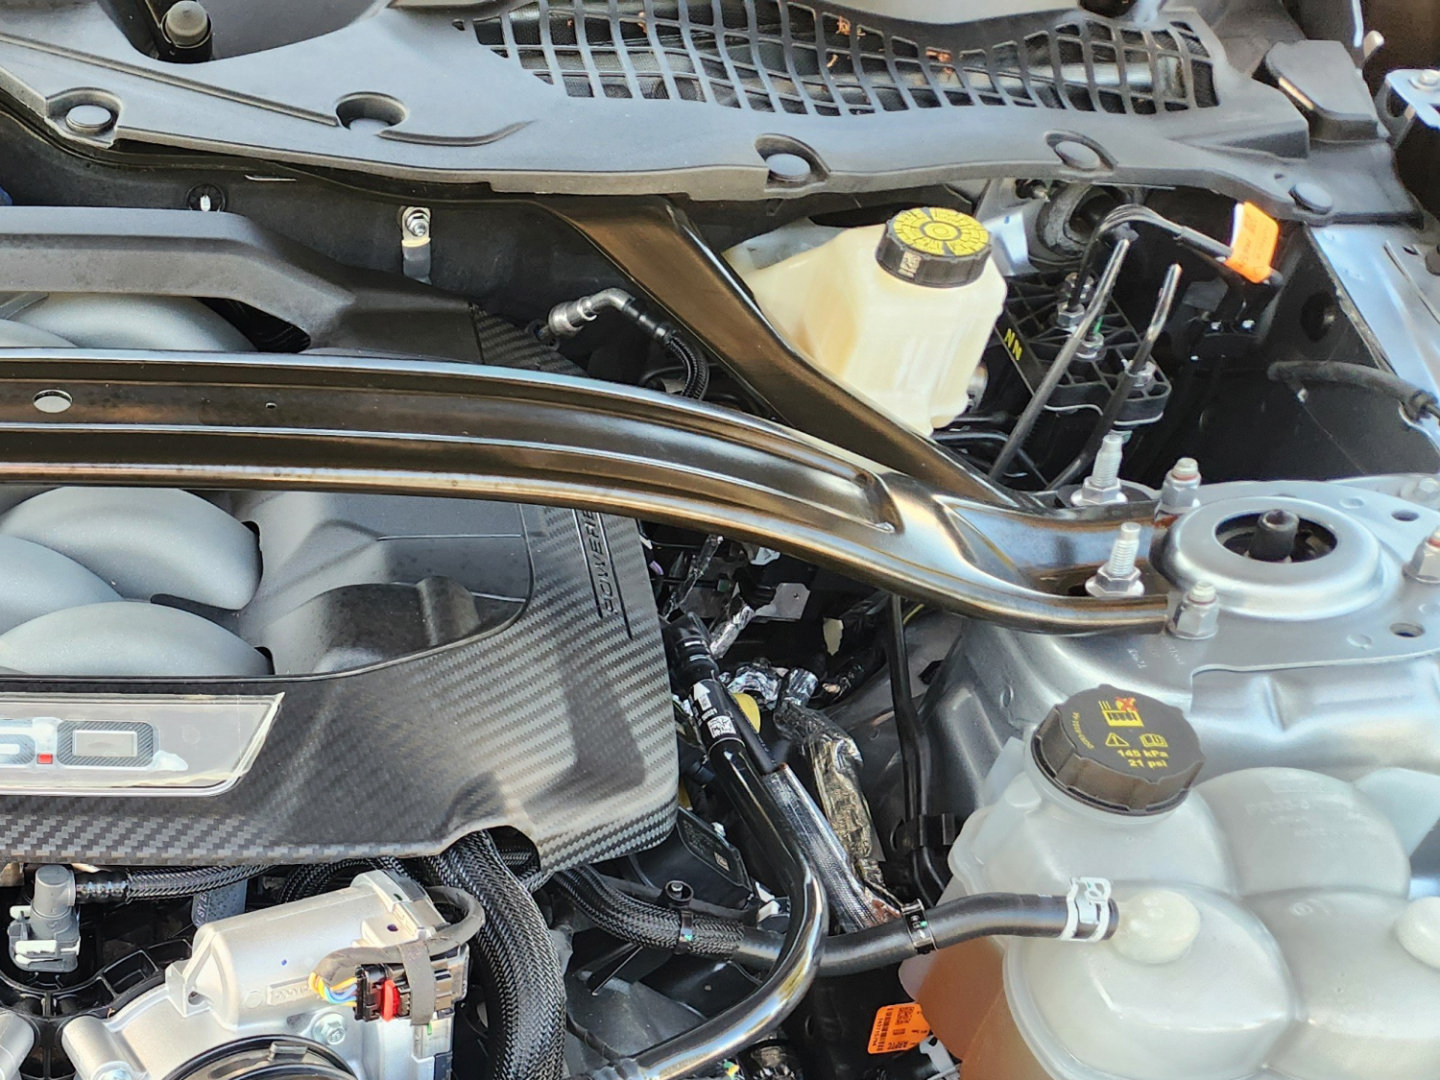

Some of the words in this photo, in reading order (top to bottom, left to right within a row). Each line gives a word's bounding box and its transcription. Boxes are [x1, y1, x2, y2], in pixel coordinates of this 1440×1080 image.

[582, 509, 619, 615] POWERE
[1143, 749, 1169, 758] kPa
[1128, 759, 1144, 768] 21
[1147, 759, 1168, 769] psi
